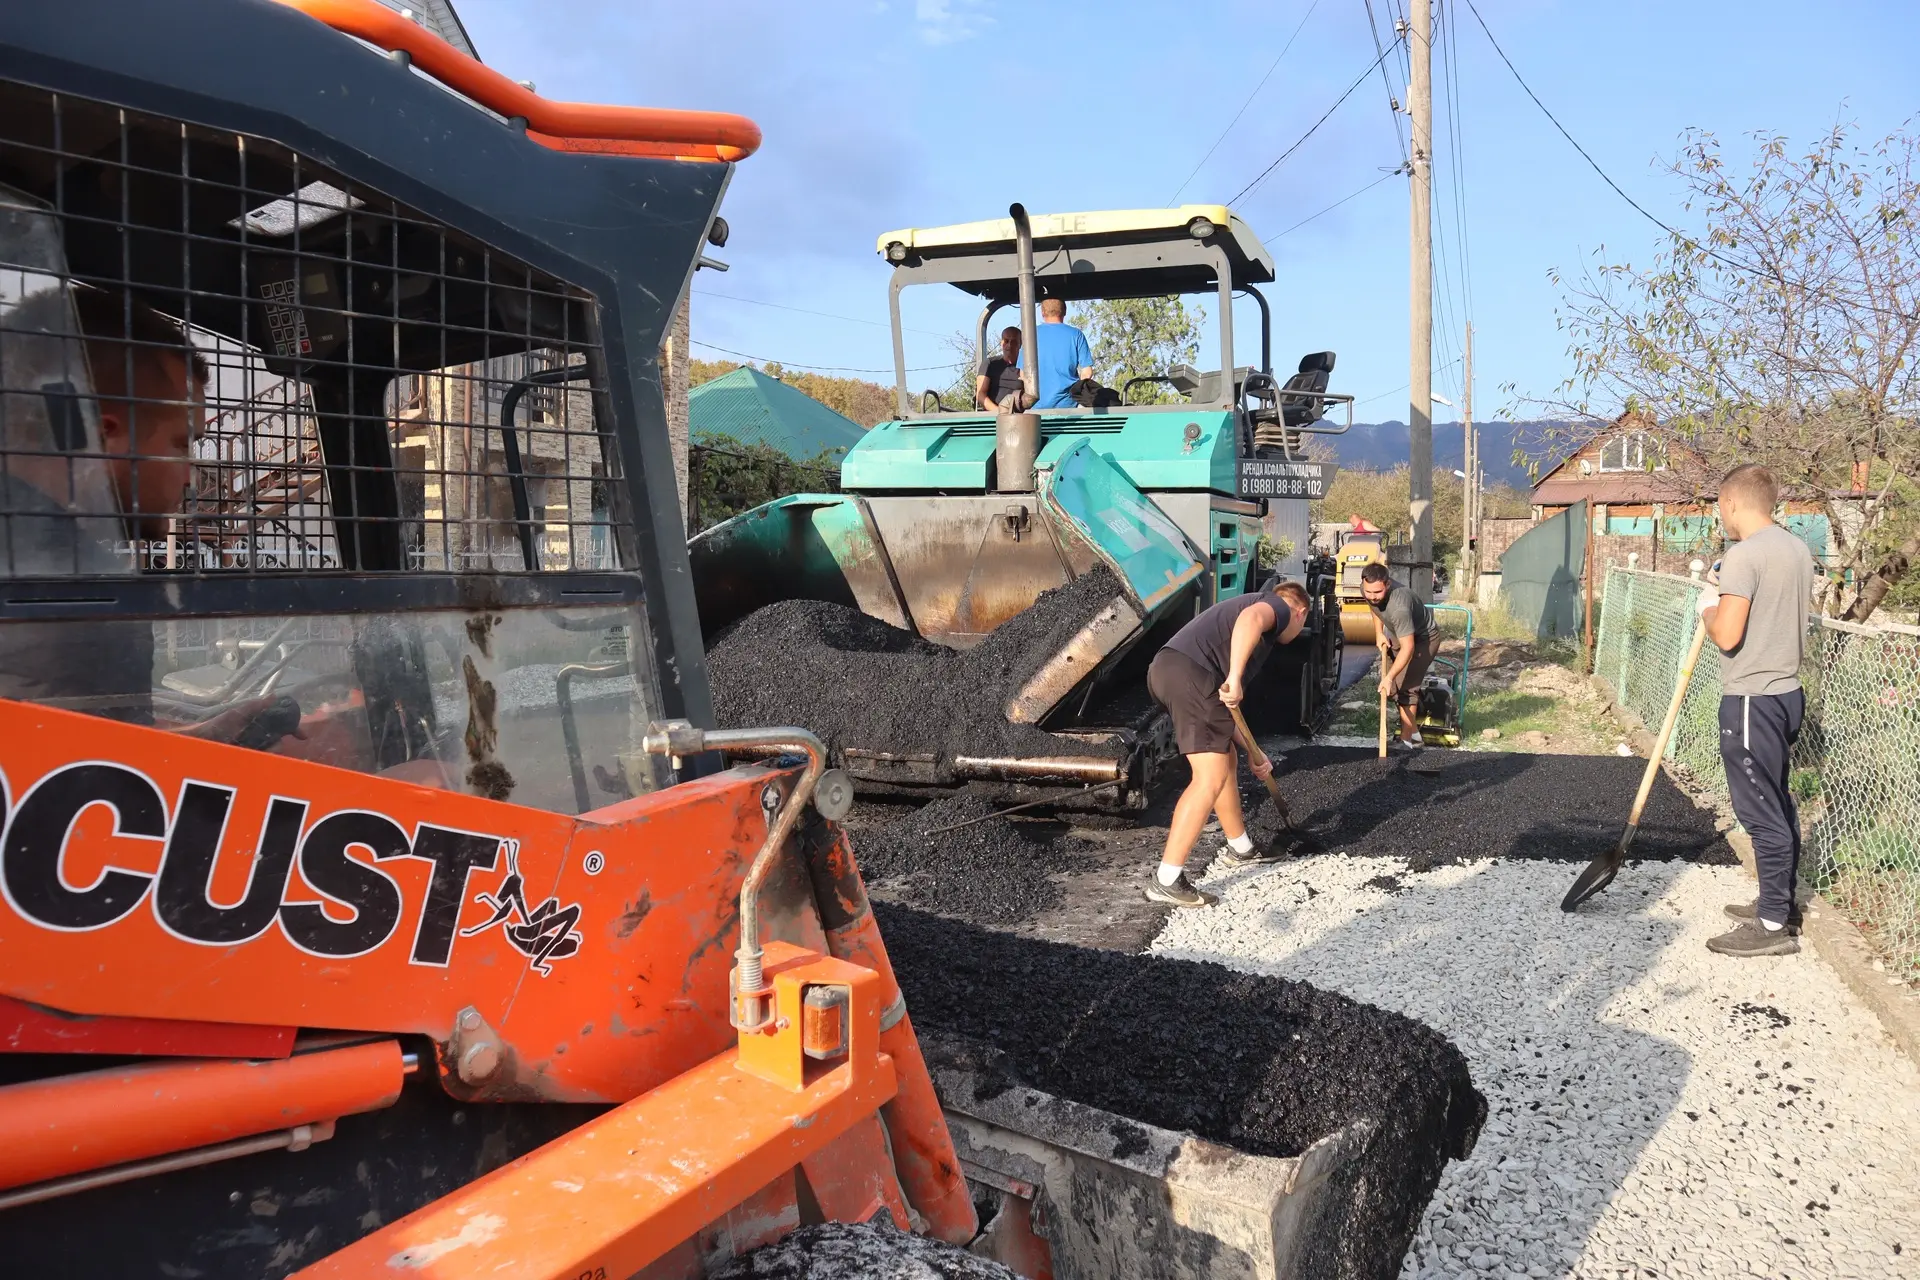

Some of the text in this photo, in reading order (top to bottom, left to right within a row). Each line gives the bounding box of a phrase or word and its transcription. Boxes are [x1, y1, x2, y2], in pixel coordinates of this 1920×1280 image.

[1242, 463, 1322, 478] АРЕНДА АСФАЛЬТОУКЛАДЧИКА
[1242, 479, 1322, 495] 8 (988) 88-88-102
[0, 760, 505, 967] CUST
